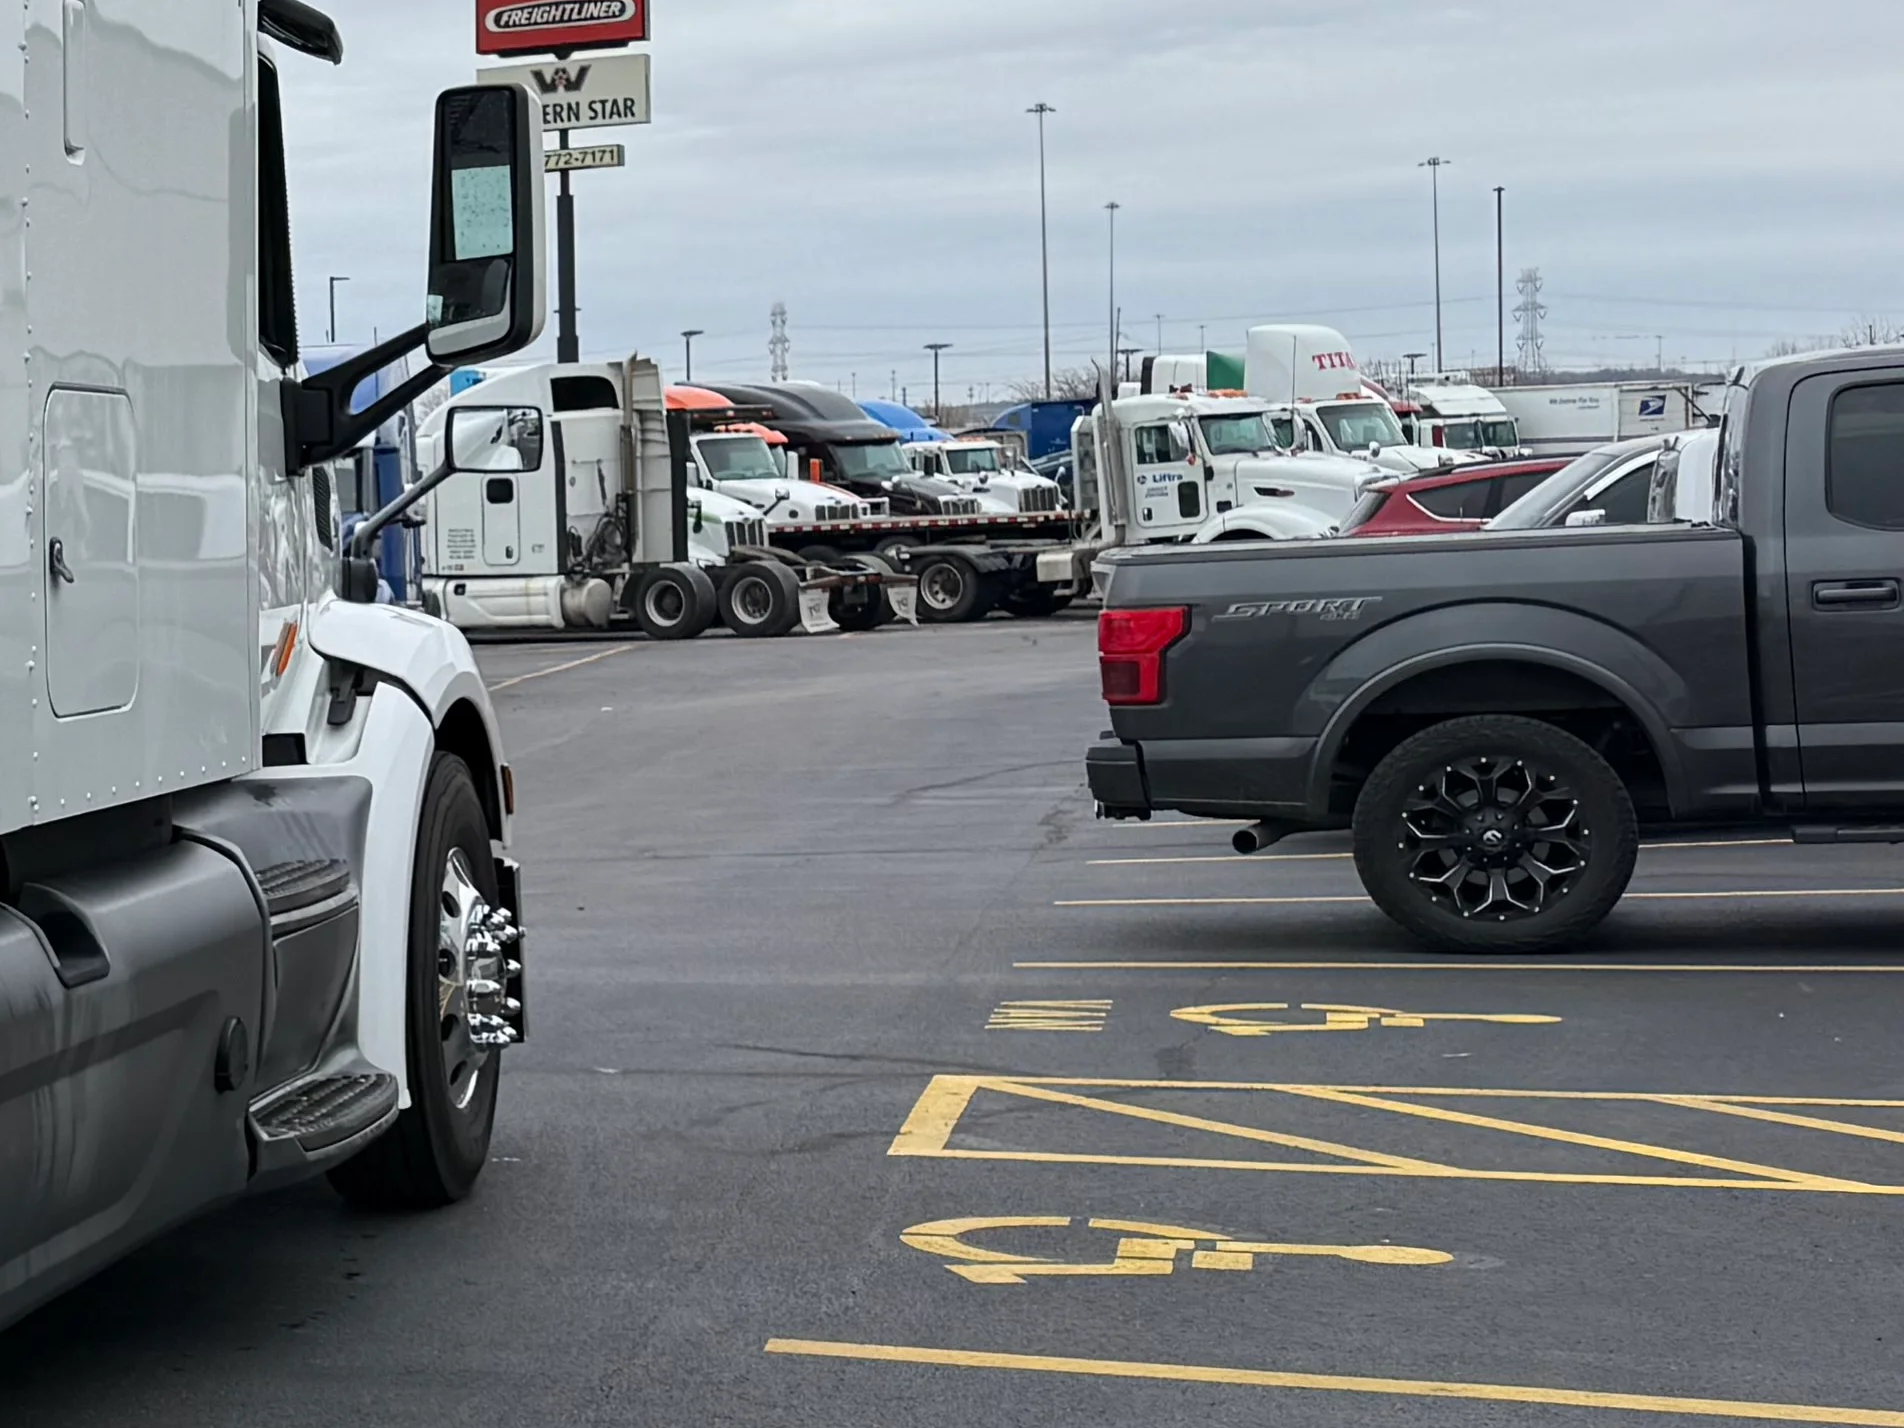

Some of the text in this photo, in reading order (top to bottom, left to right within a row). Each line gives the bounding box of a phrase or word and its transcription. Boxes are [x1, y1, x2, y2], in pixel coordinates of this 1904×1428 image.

[499, 0, 622, 27] FREIGHTLINER
[543, 97, 636, 124] ERN STAR
[1153, 473, 1183, 483] Liftra
[1211, 595, 1382, 622] SPORT
